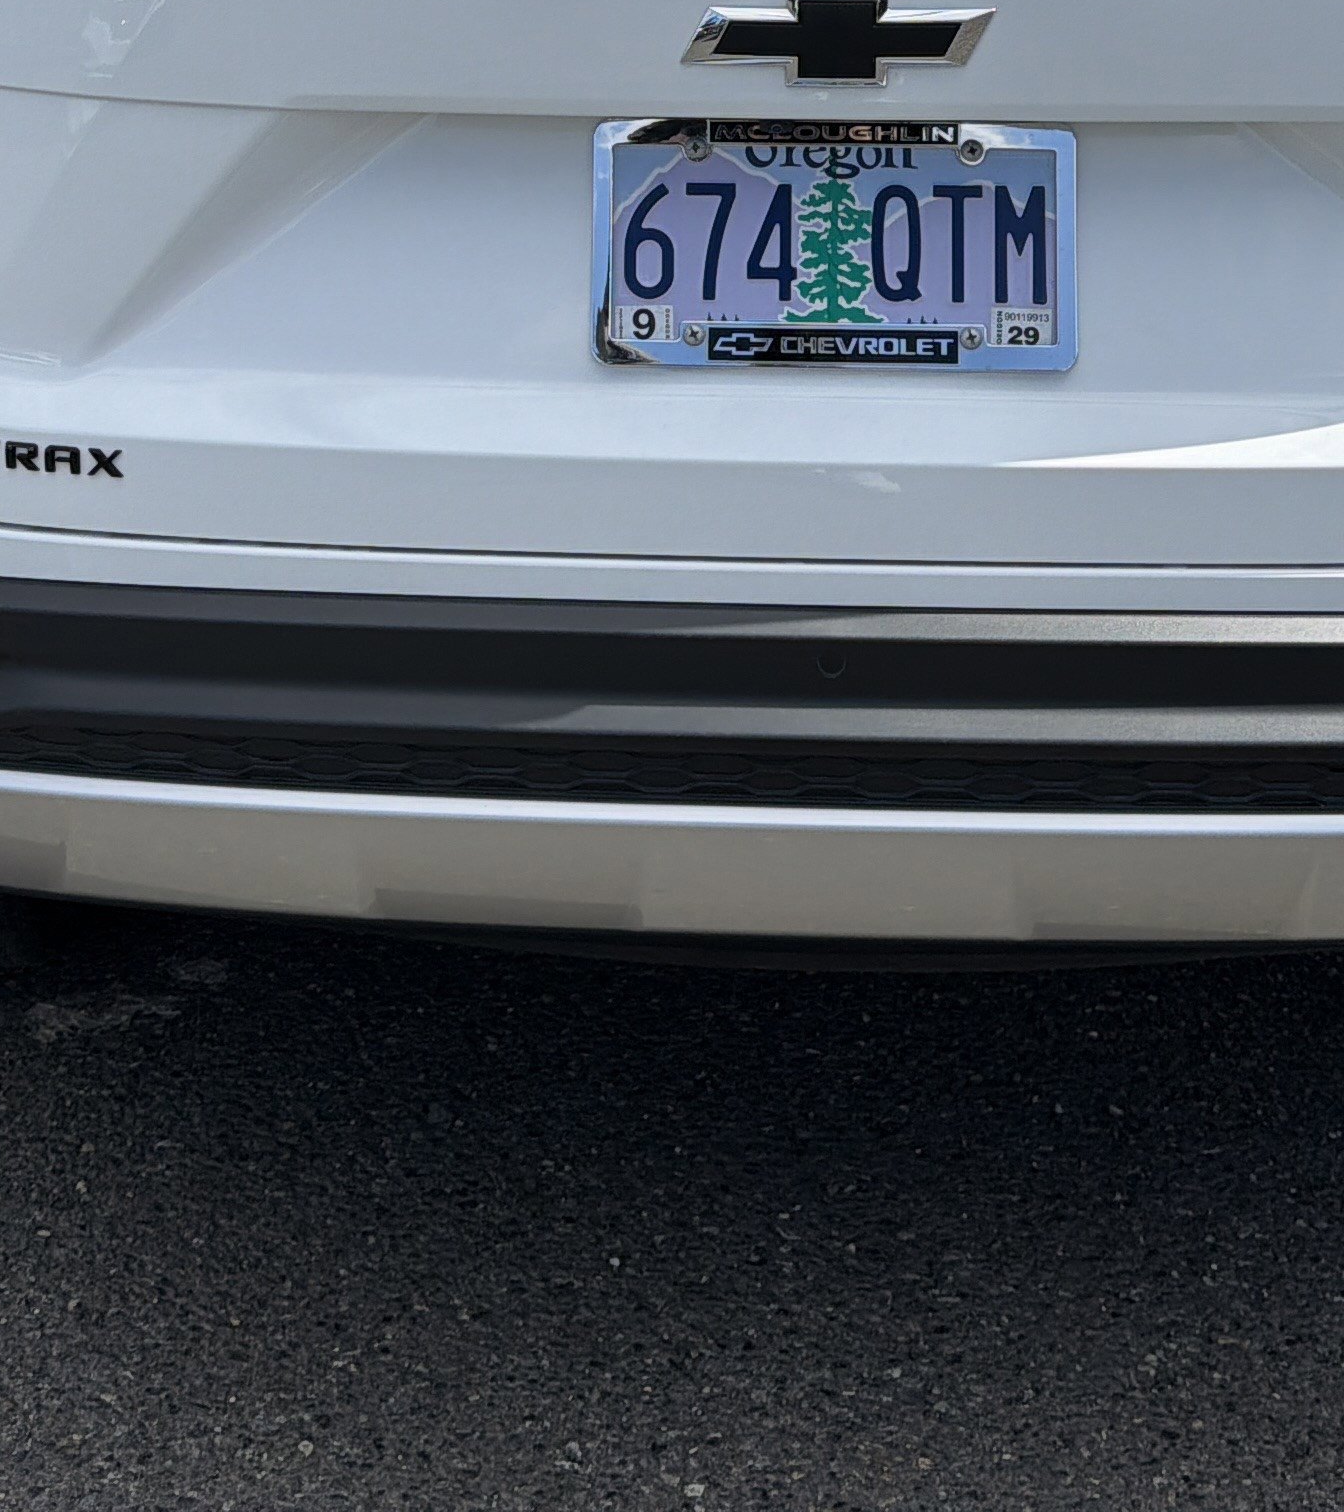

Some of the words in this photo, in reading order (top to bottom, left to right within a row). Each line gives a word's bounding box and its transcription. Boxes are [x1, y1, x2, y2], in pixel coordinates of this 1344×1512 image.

[623, 182, 797, 302] 674
[871, 185, 1048, 304] QTM
[632, 308, 656, 340] 9
[1007, 325, 1040, 345] 29
[779, 336, 954, 356] CHEVROLET
